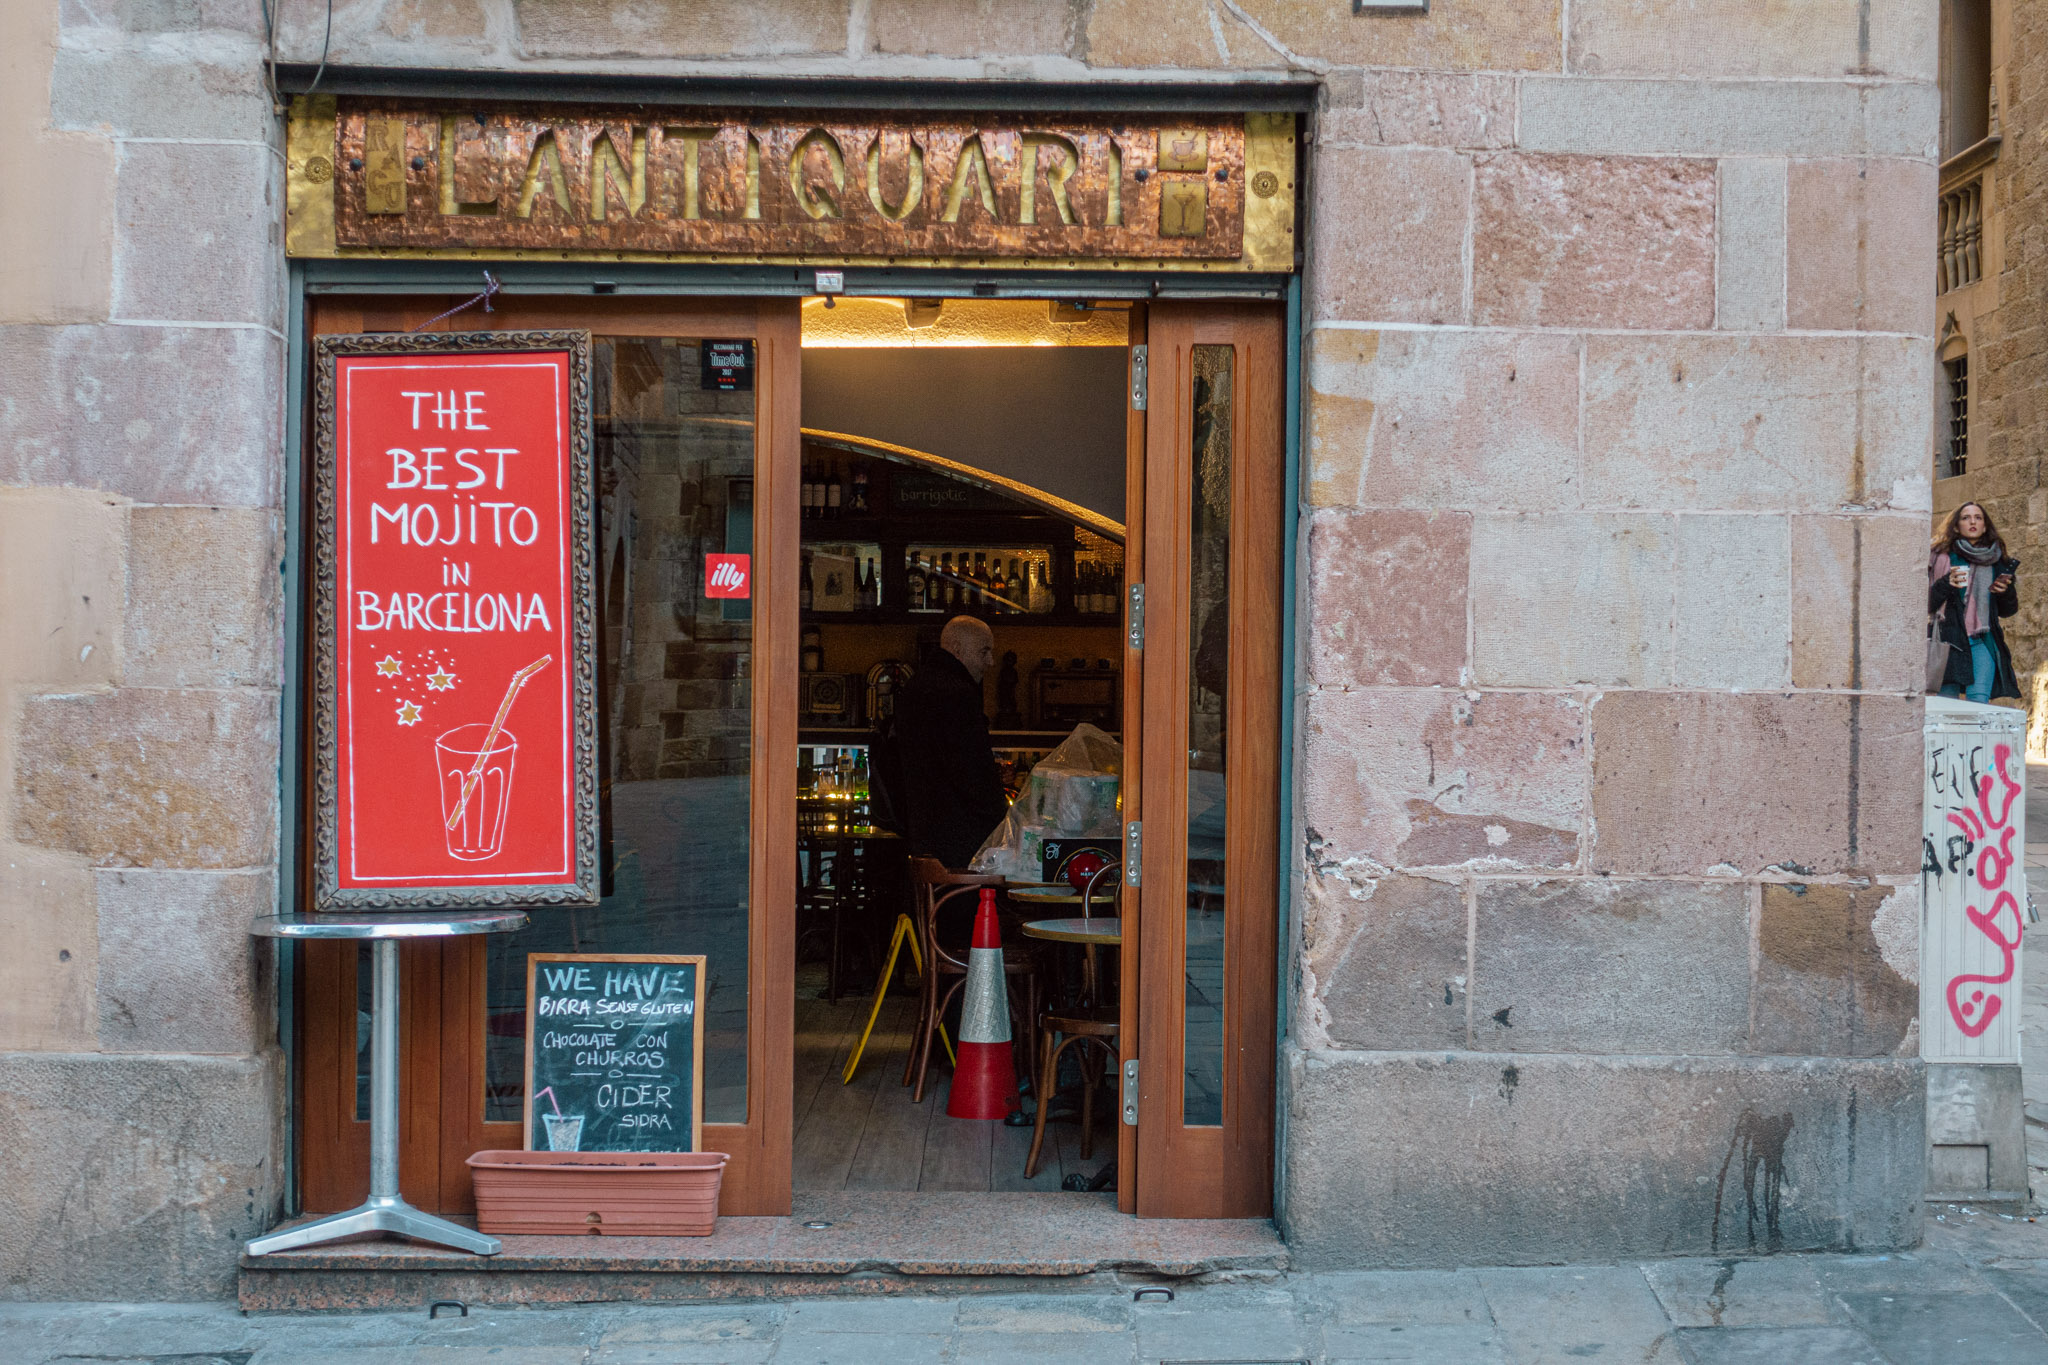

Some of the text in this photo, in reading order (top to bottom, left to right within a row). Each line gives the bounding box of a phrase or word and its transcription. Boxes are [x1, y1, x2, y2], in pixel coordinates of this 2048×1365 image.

[710, 352, 745, 367] Time Out
[401, 389, 491, 431] THE
[385, 447, 521, 490] BEST
[710, 562, 745, 592] illy
[356, 590, 553, 633] BARCELONA
[544, 966, 685, 1000] WE HAVE
[538, 996, 694, 1016] BIRRA SENSE GLUTEN
[543, 1031, 668, 1050] CHOCOLATE CON
[575, 1051, 665, 1069] CHURROS
[597, 1084, 673, 1109] CIDER
[618, 1114, 672, 1131] SIDRA
